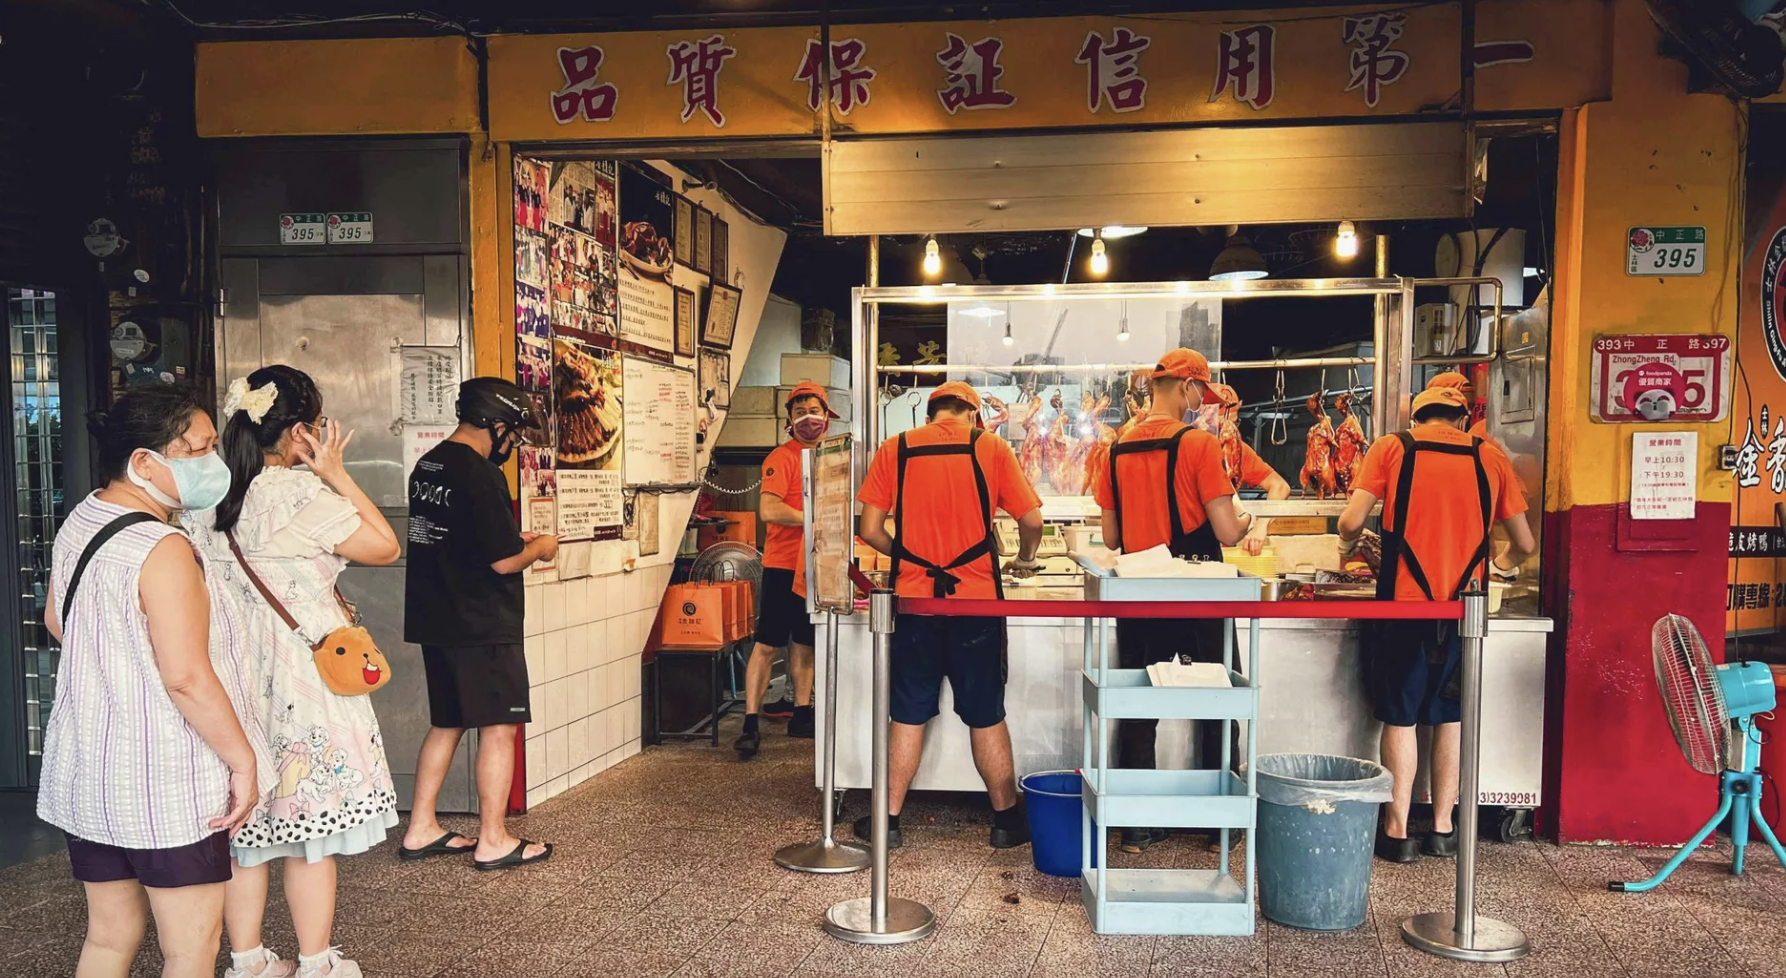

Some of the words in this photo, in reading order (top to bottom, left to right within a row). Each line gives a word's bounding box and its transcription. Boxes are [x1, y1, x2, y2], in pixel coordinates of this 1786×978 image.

[291, 228, 314, 241] 395
[338, 227, 361, 240] 395
[1655, 228, 1704, 241] 中正路
[1631, 254, 1639, 273] 士林區
[1653, 248, 1697, 268] 395
[1597, 339, 1622, 350] 393
[1623, 339, 1700, 351] 中正路
[1702, 338, 1727, 349] 397
[1612, 355, 1660, 365] ZhongZheng
[1614, 369, 1706, 408] 35
[1638, 378, 1672, 386] 優質商家
[1649, 438, 1682, 447] 營業時間
